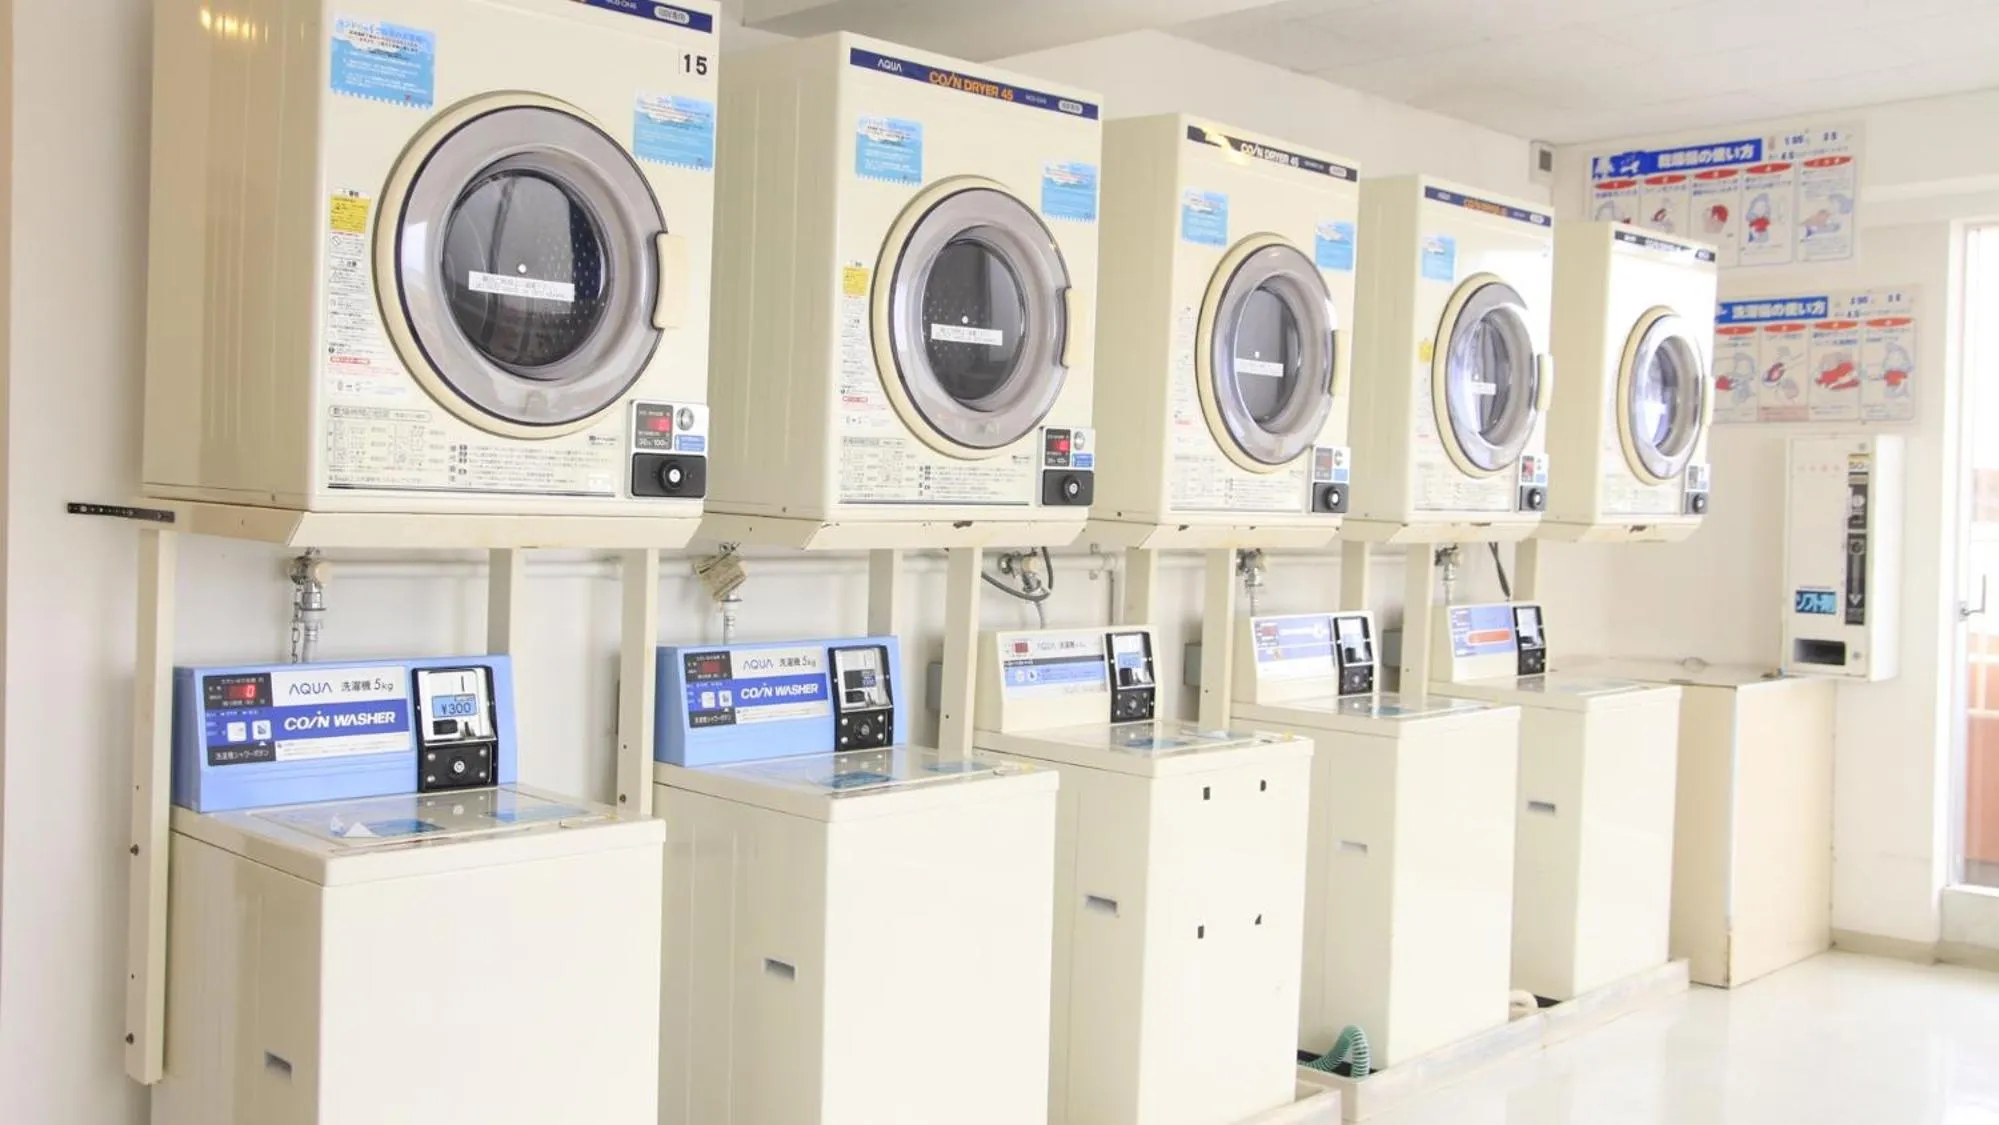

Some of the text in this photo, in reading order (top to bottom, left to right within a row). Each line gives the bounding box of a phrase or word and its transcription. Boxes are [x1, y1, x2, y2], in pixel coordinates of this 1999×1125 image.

[683, 53, 708, 76] 15
[877, 58, 903, 72] AQUA
[963, 79, 1000, 98] DRYER
[1000, 88, 1014, 102] 45
[743, 658, 774, 671] AQUA
[289, 682, 333, 696] AQUA
[340, 676, 394, 692] 洗濯機 5kg
[740, 682, 819, 700] COIN WASHER
[441, 702, 471, 716] ¥300
[284, 710, 396, 731] COIN WASHER
